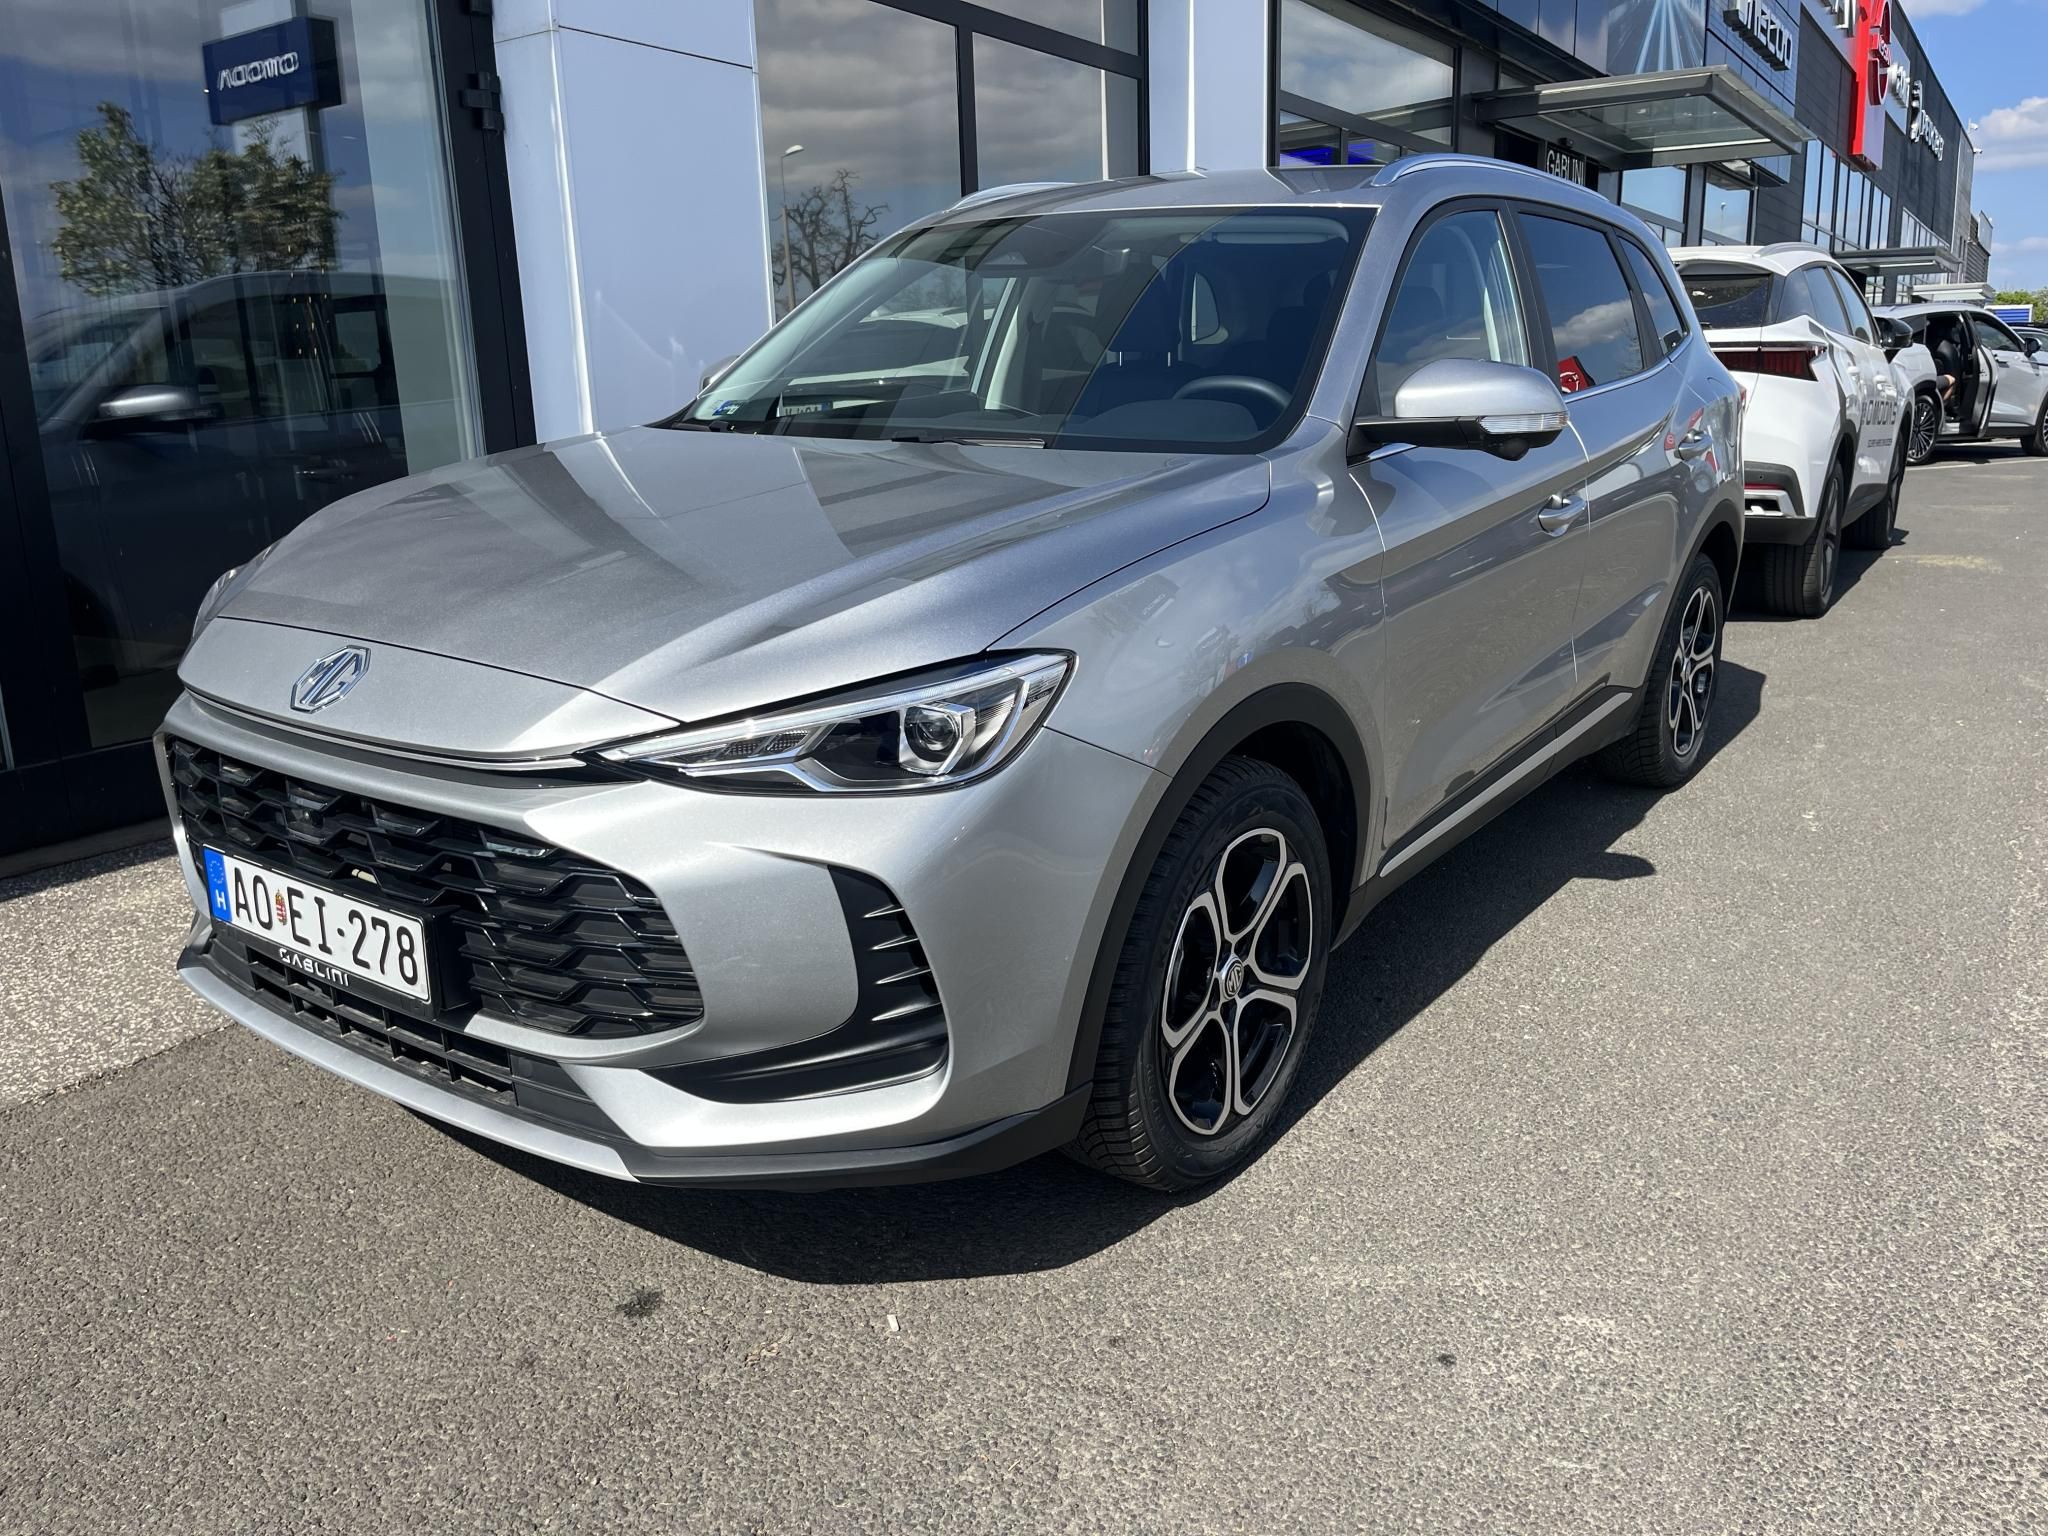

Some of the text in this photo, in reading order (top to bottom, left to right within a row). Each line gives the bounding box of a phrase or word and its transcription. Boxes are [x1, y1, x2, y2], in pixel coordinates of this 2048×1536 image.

[297, 649, 366, 708] MG
[215, 889, 227, 911] H
[279, 948, 349, 987] GABLINI
[1228, 964, 1241, 993] MG
